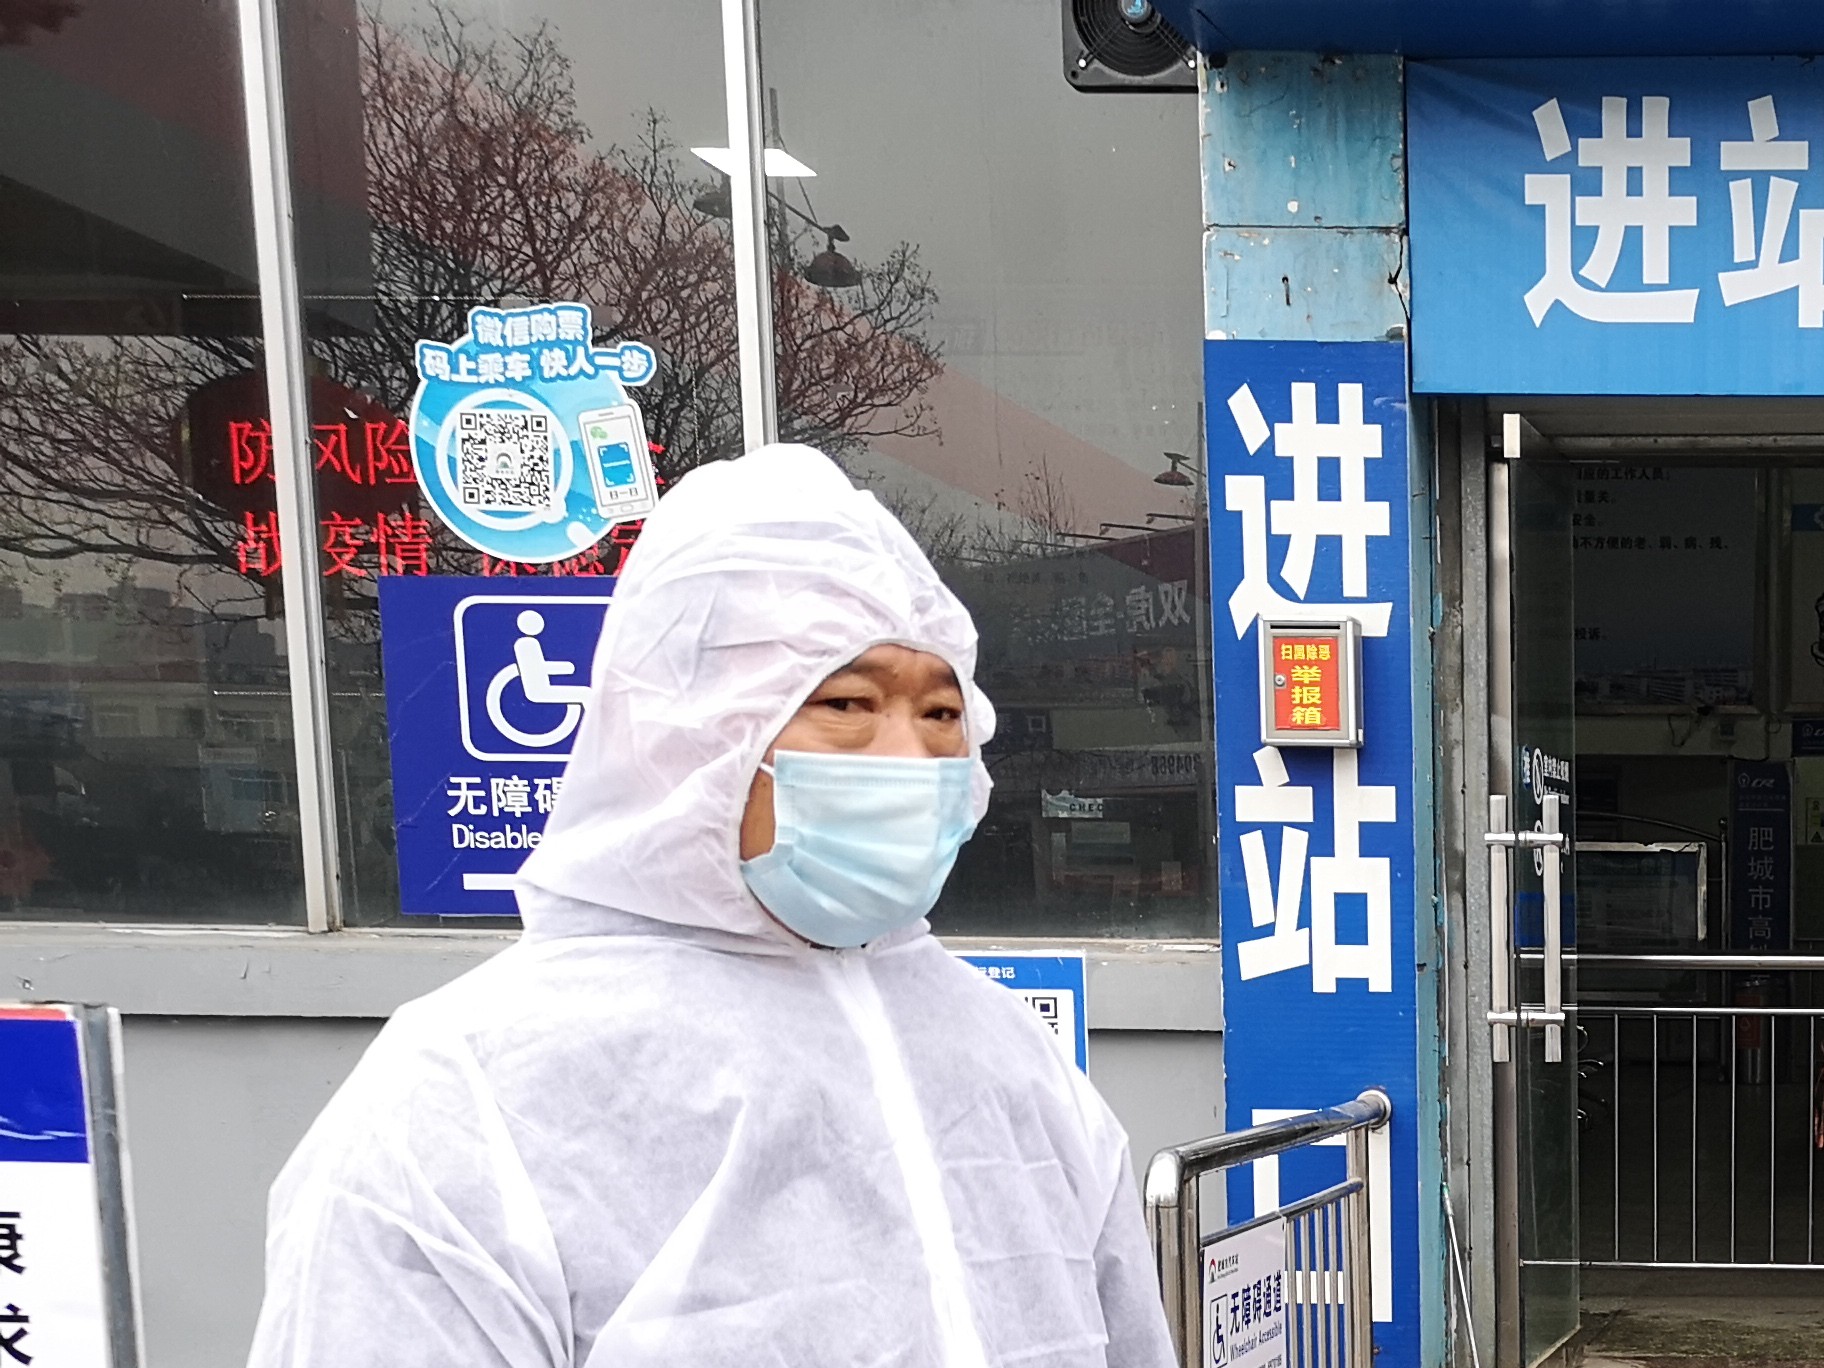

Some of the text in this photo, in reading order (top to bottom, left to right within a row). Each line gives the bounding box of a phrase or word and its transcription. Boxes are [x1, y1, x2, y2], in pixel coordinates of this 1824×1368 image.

[475, 309, 585, 349] 微信购票
[424, 346, 650, 384] 码上乘车 快人一步
[1280, 643, 1331, 661] 扫黑除恶
[1290, 665, 1323, 726] 举报箱
[1229, 1269, 1282, 1337] 无障碍通道
